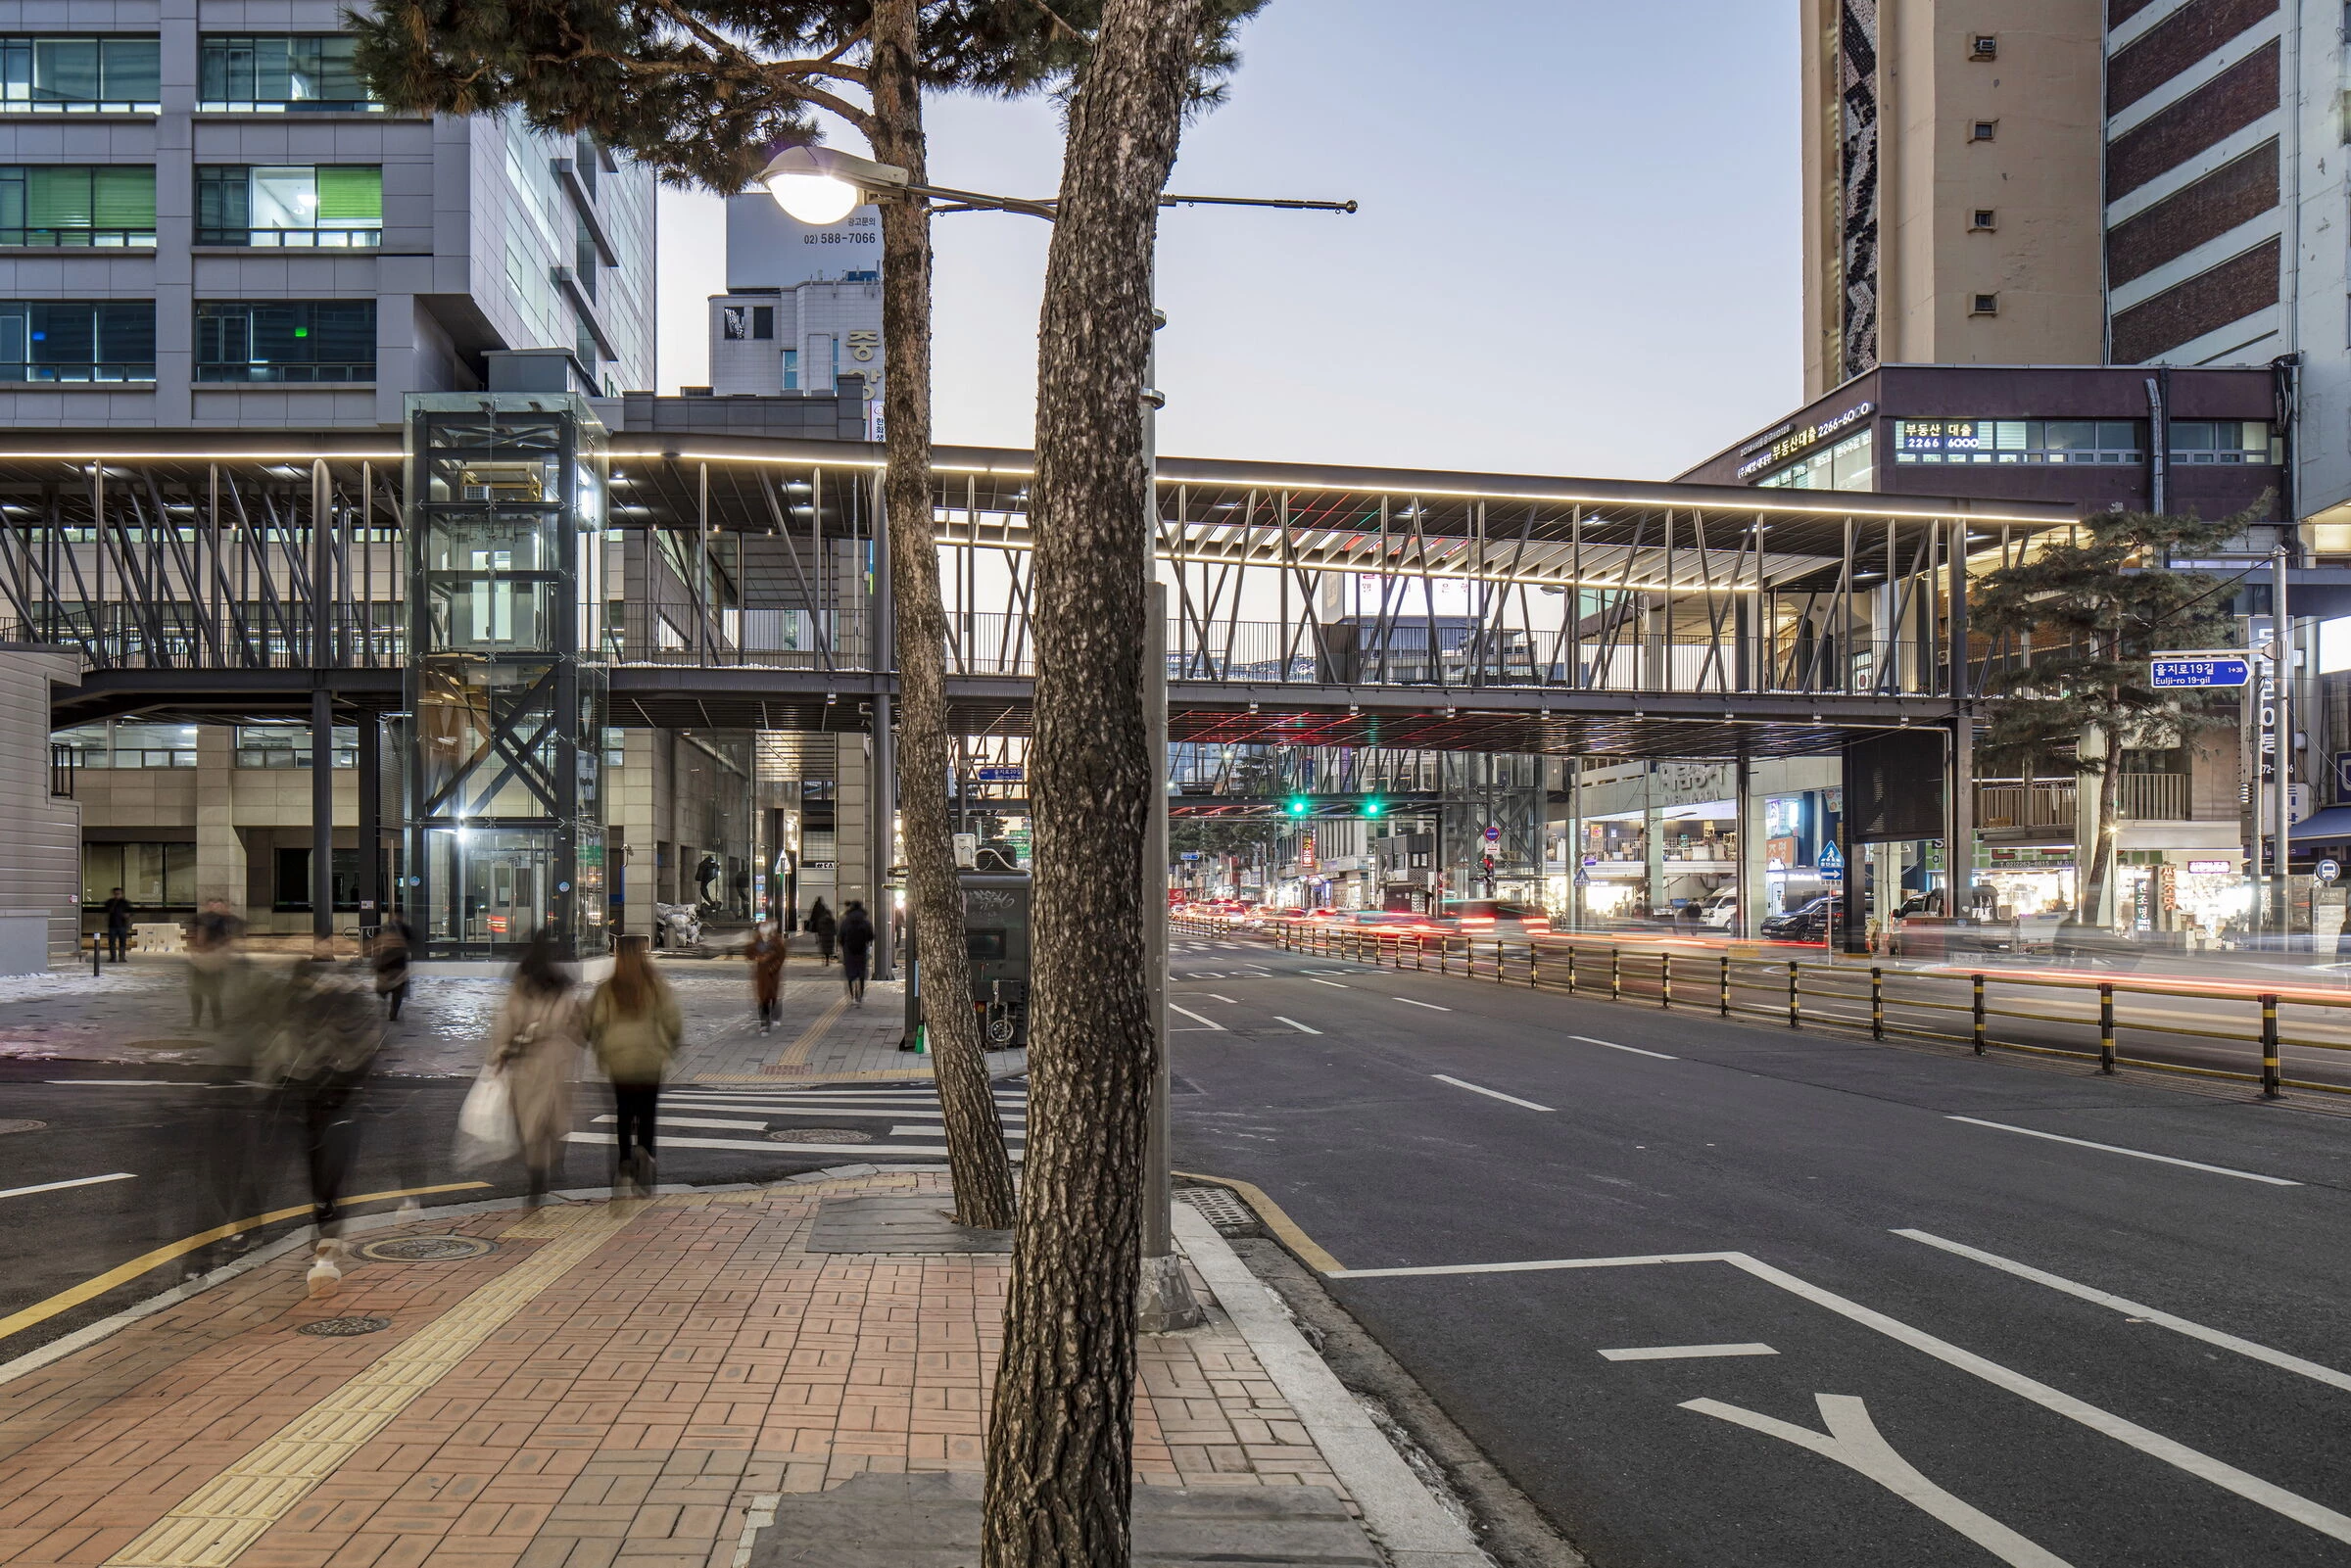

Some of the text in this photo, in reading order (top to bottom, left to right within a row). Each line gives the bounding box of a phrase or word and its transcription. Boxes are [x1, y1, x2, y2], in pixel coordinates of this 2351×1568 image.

[803, 232, 876, 245] 02) 588-7066
[1772, 425, 1817, 460] 부동산대출
[1817, 402, 1869, 438] 2266-6000
[1905, 423, 1973, 436] 부동산 대출
[1907, 438, 1980, 449] 2266 6000
[2155, 663, 2214, 676] 을지로19길
[2155, 676, 2211, 686] Eulji-ro 19-gil
